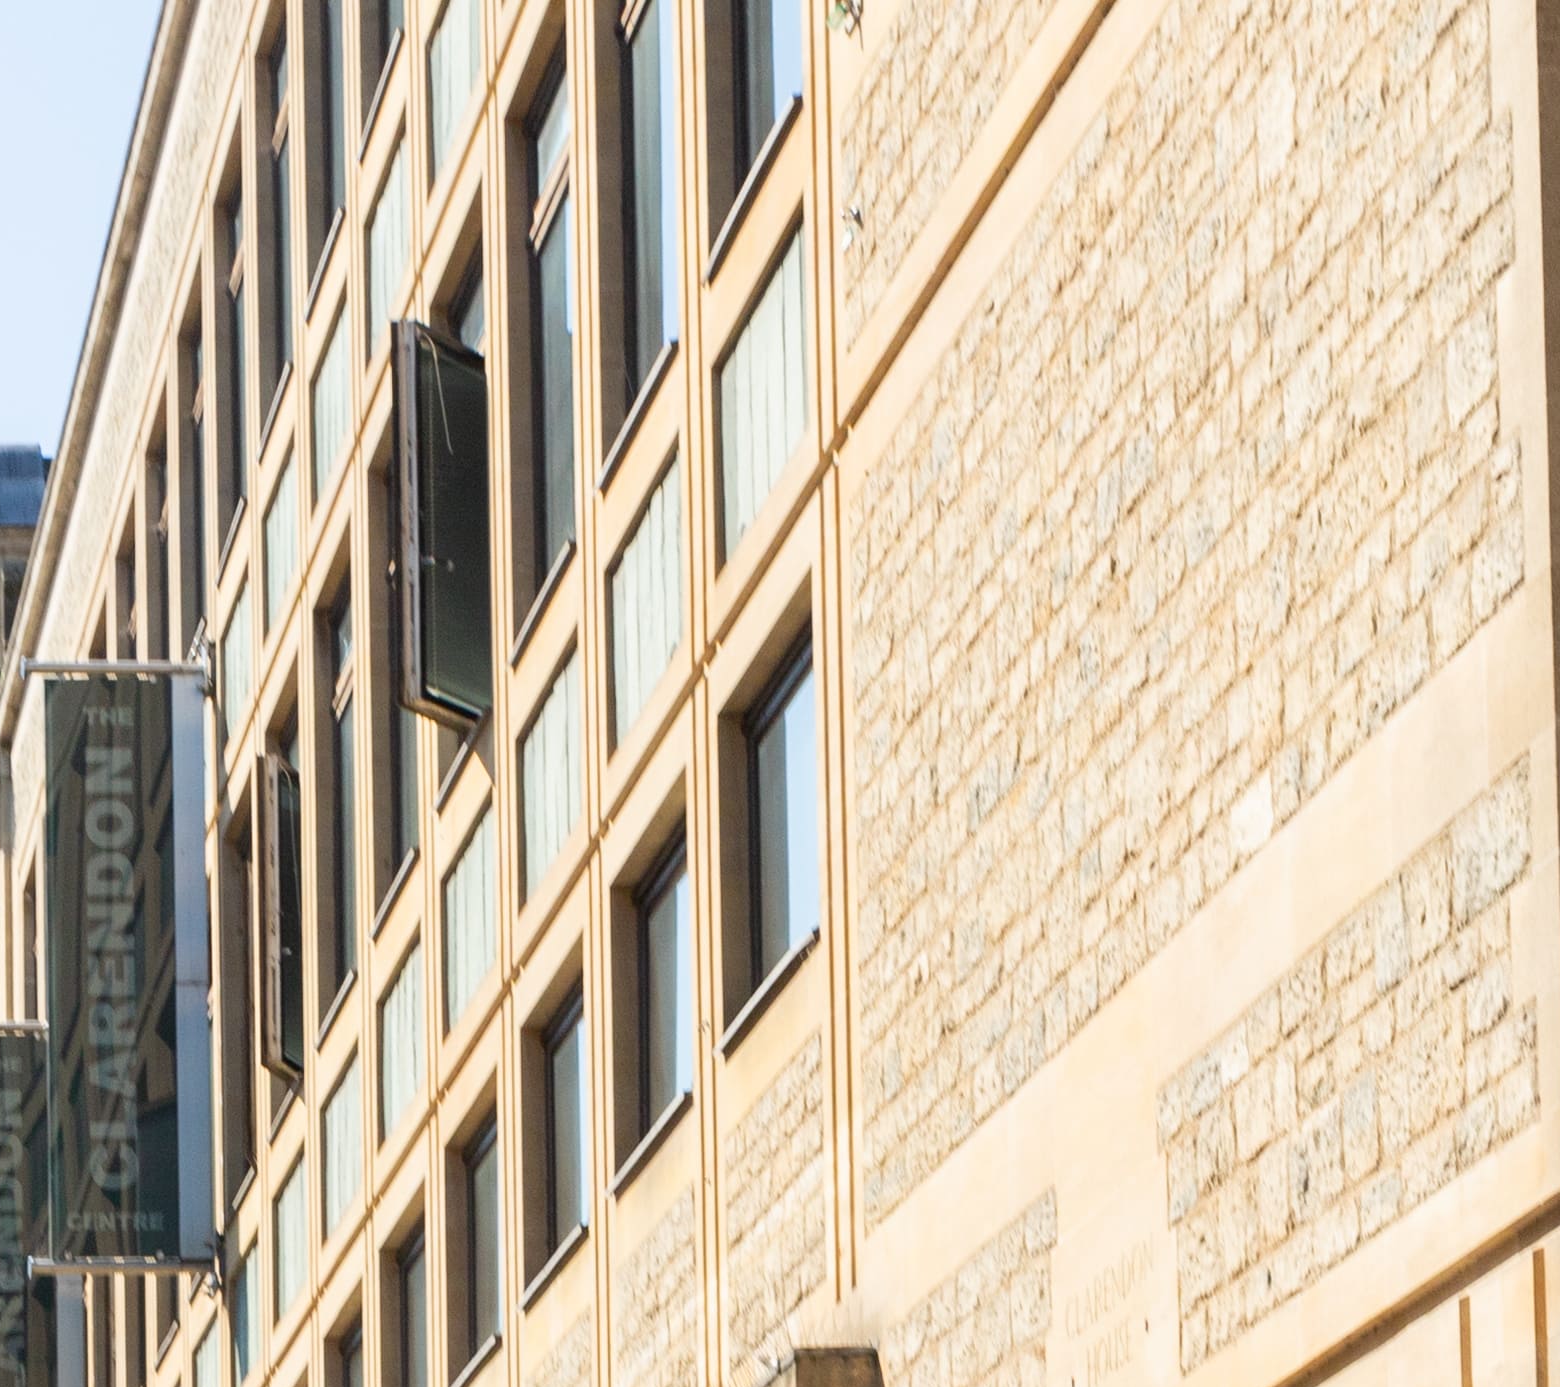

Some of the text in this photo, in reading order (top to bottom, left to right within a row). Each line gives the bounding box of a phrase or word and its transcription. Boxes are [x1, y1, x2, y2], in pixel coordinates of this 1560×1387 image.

[83, 704, 135, 728] THE
[84, 744, 137, 1194] CLARENDON
[66, 1210, 165, 1235] CENTRE
